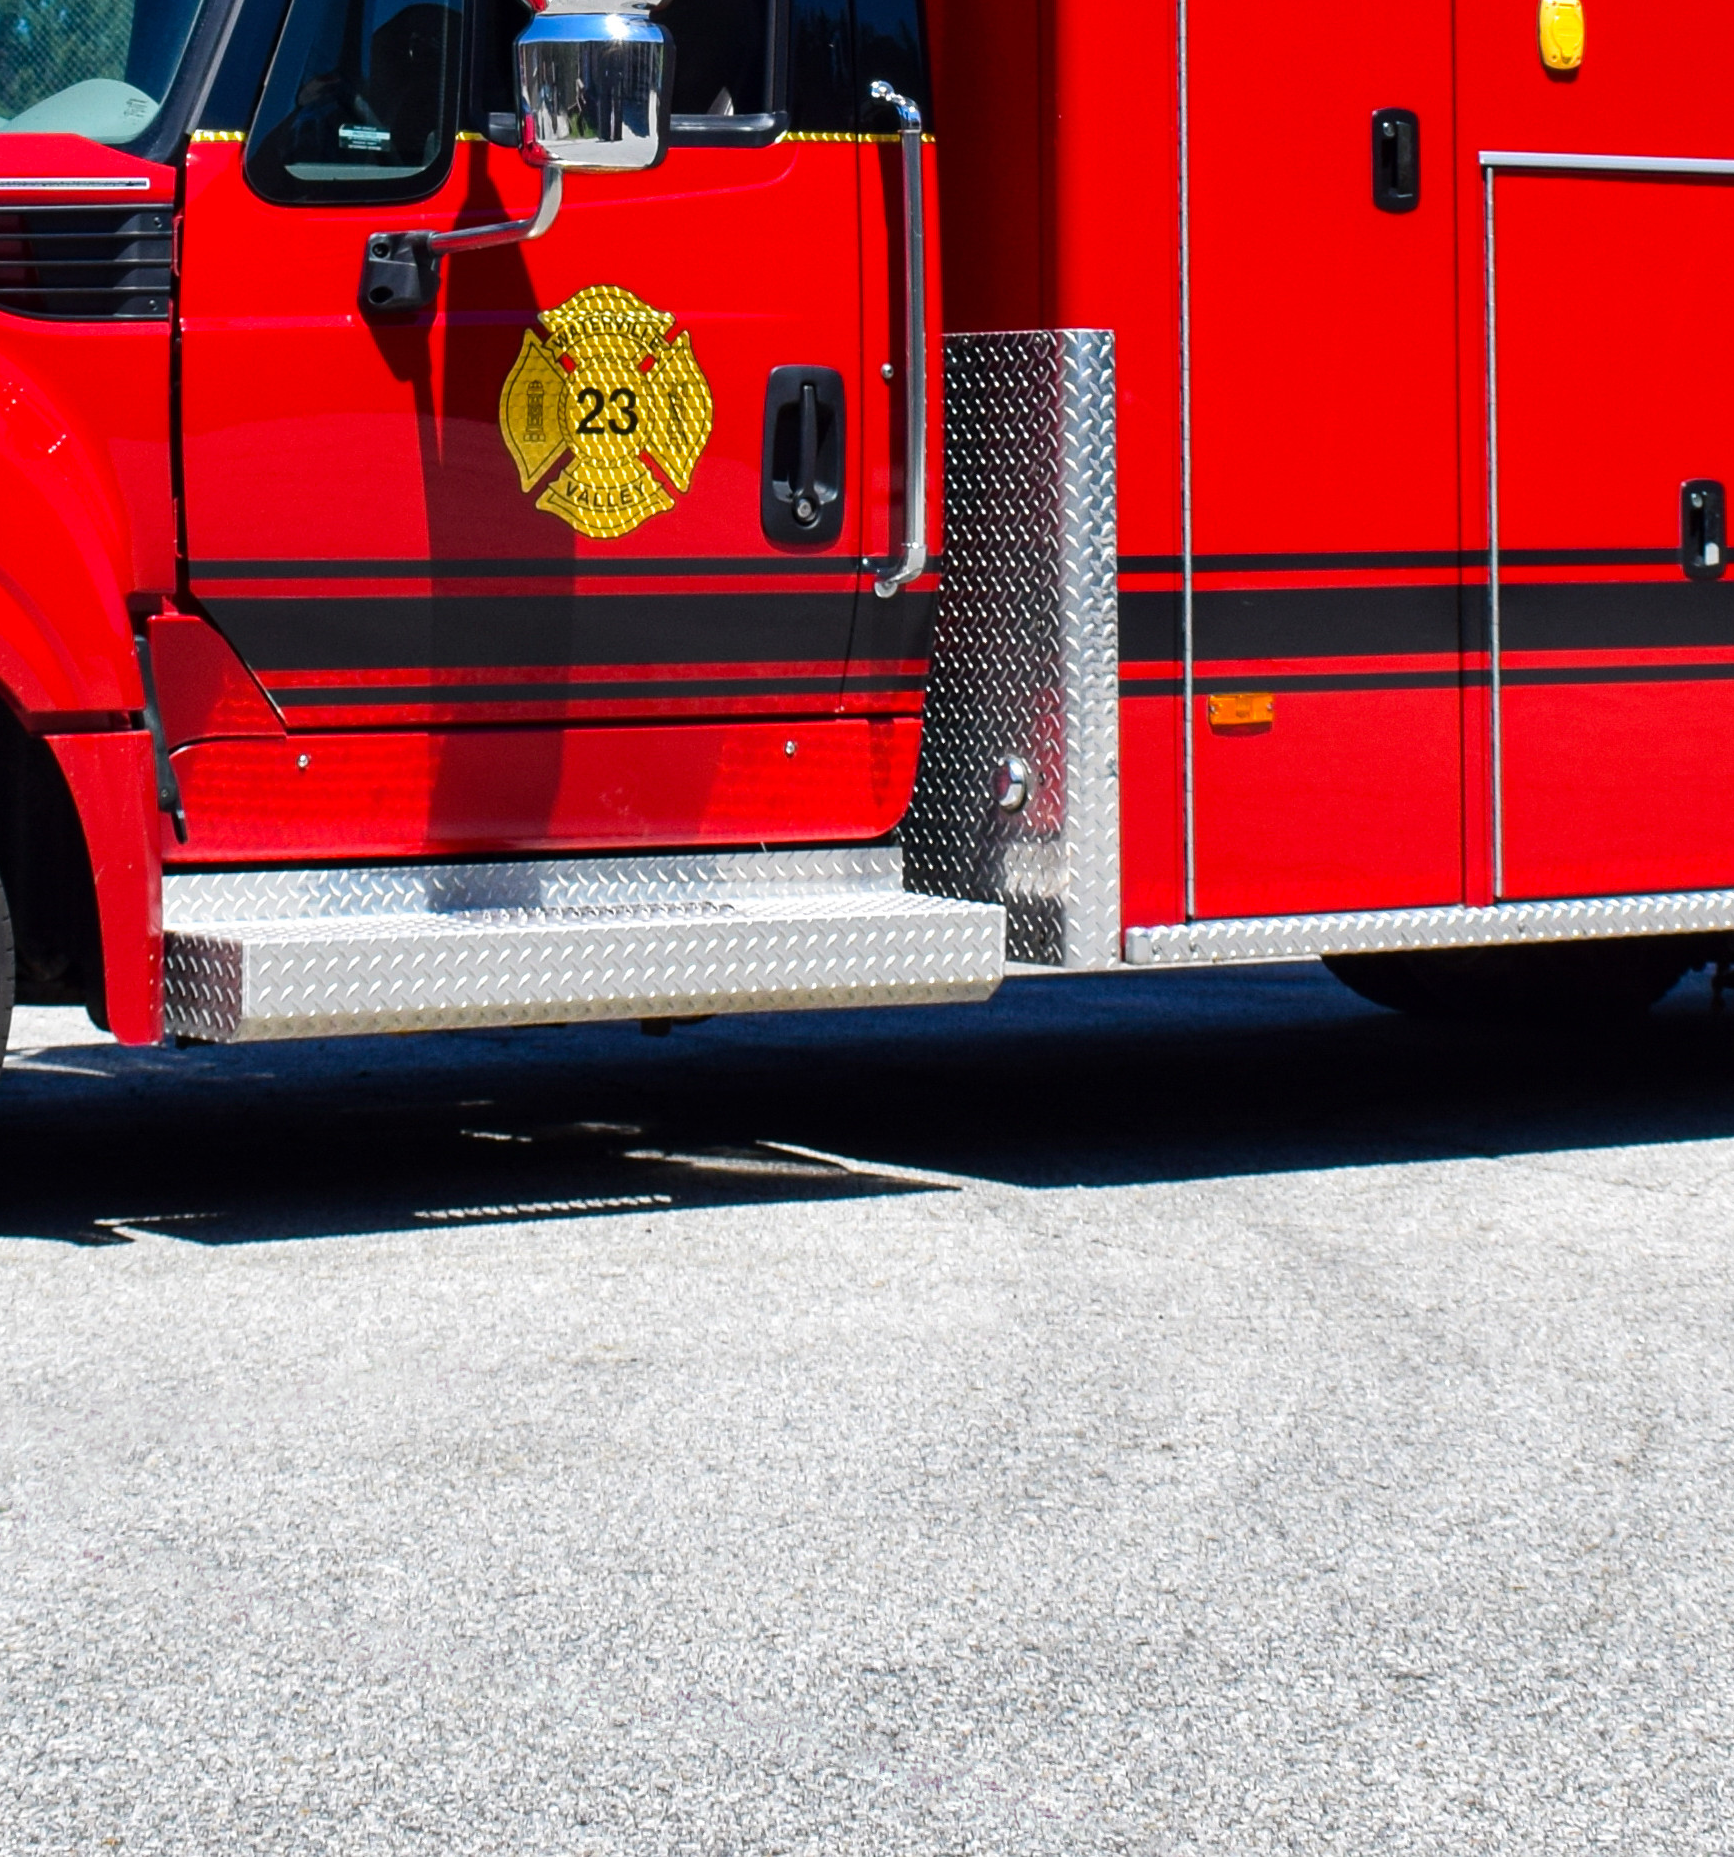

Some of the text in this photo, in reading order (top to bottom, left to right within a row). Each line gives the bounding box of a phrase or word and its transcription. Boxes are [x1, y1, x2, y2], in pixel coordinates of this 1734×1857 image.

[553, 314, 668, 352] WATERVILLE
[576, 387, 639, 435] 23
[567, 480, 645, 507] VALLEY
